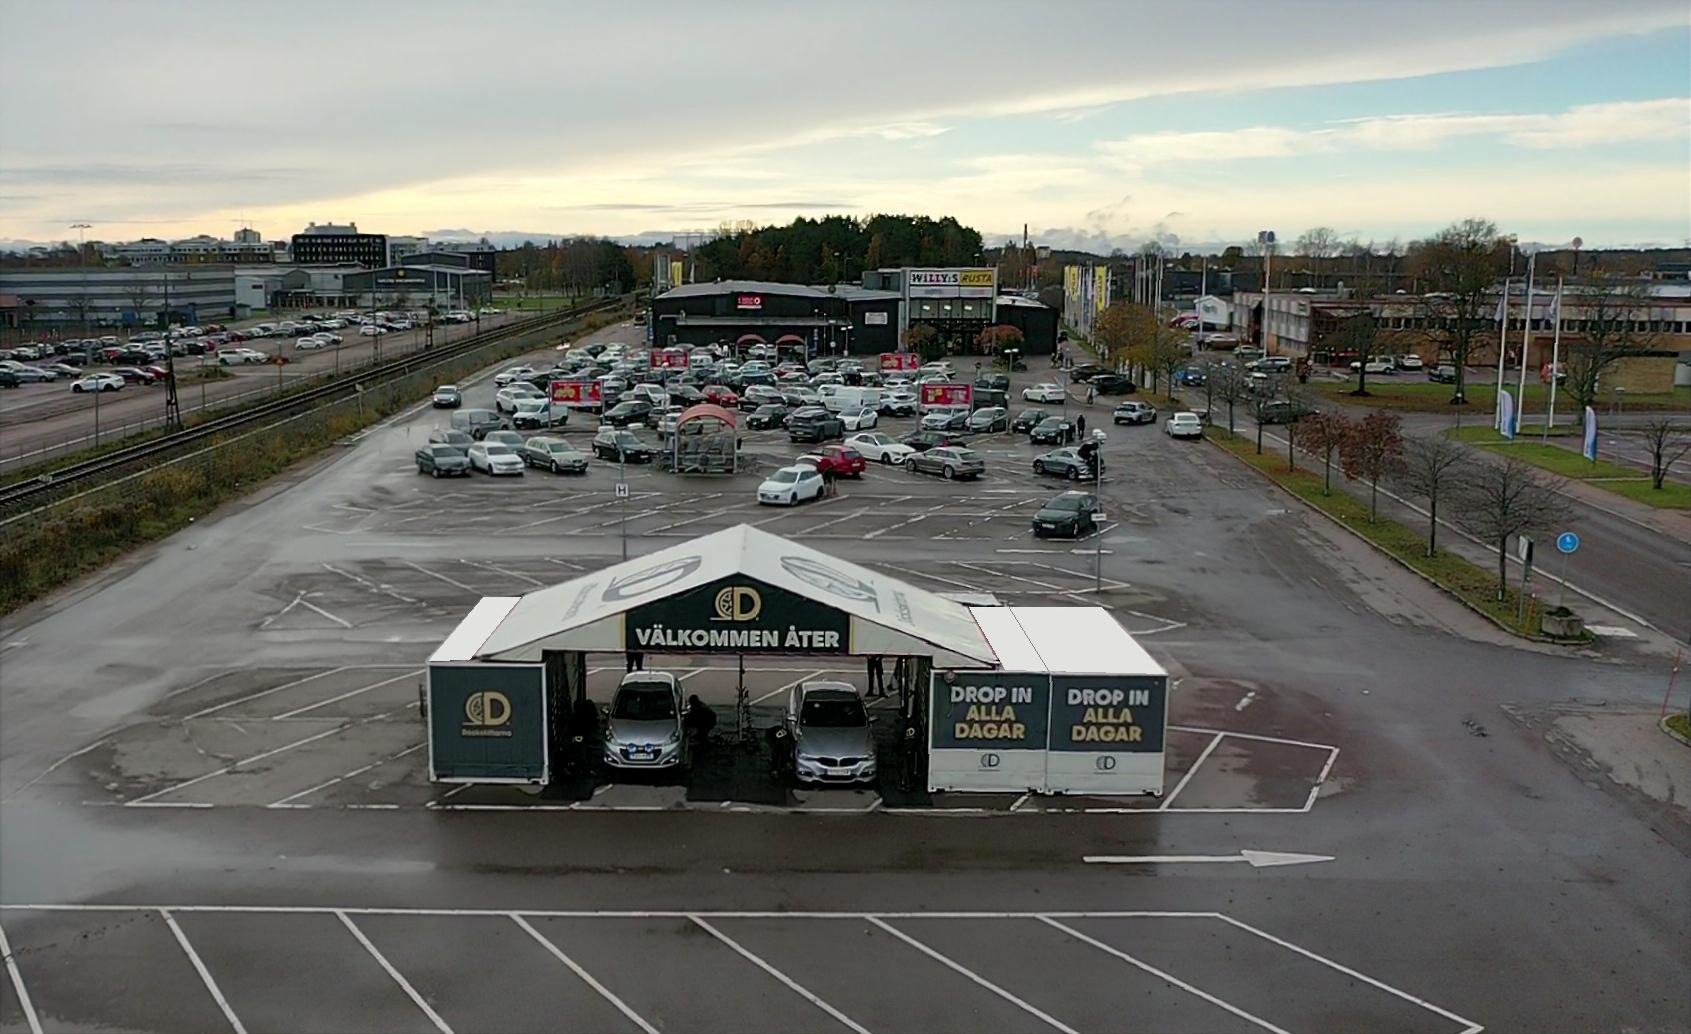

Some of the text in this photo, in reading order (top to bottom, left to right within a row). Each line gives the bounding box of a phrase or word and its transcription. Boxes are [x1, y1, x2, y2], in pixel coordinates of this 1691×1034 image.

[961, 273, 992, 283] RUSTA
[618, 485, 626, 495] H
[635, 624, 839, 647] VÄLKOMMEN ÅTER
[950, 687, 1032, 703] DROP IN
[1067, 689, 1149, 705] DROP IN
[966, 705, 1016, 721] ALLA
[1083, 708, 1133, 723] ALLA
[955, 723, 1025, 739] DAGAR
[1071, 725, 1142, 741] DAGAR
